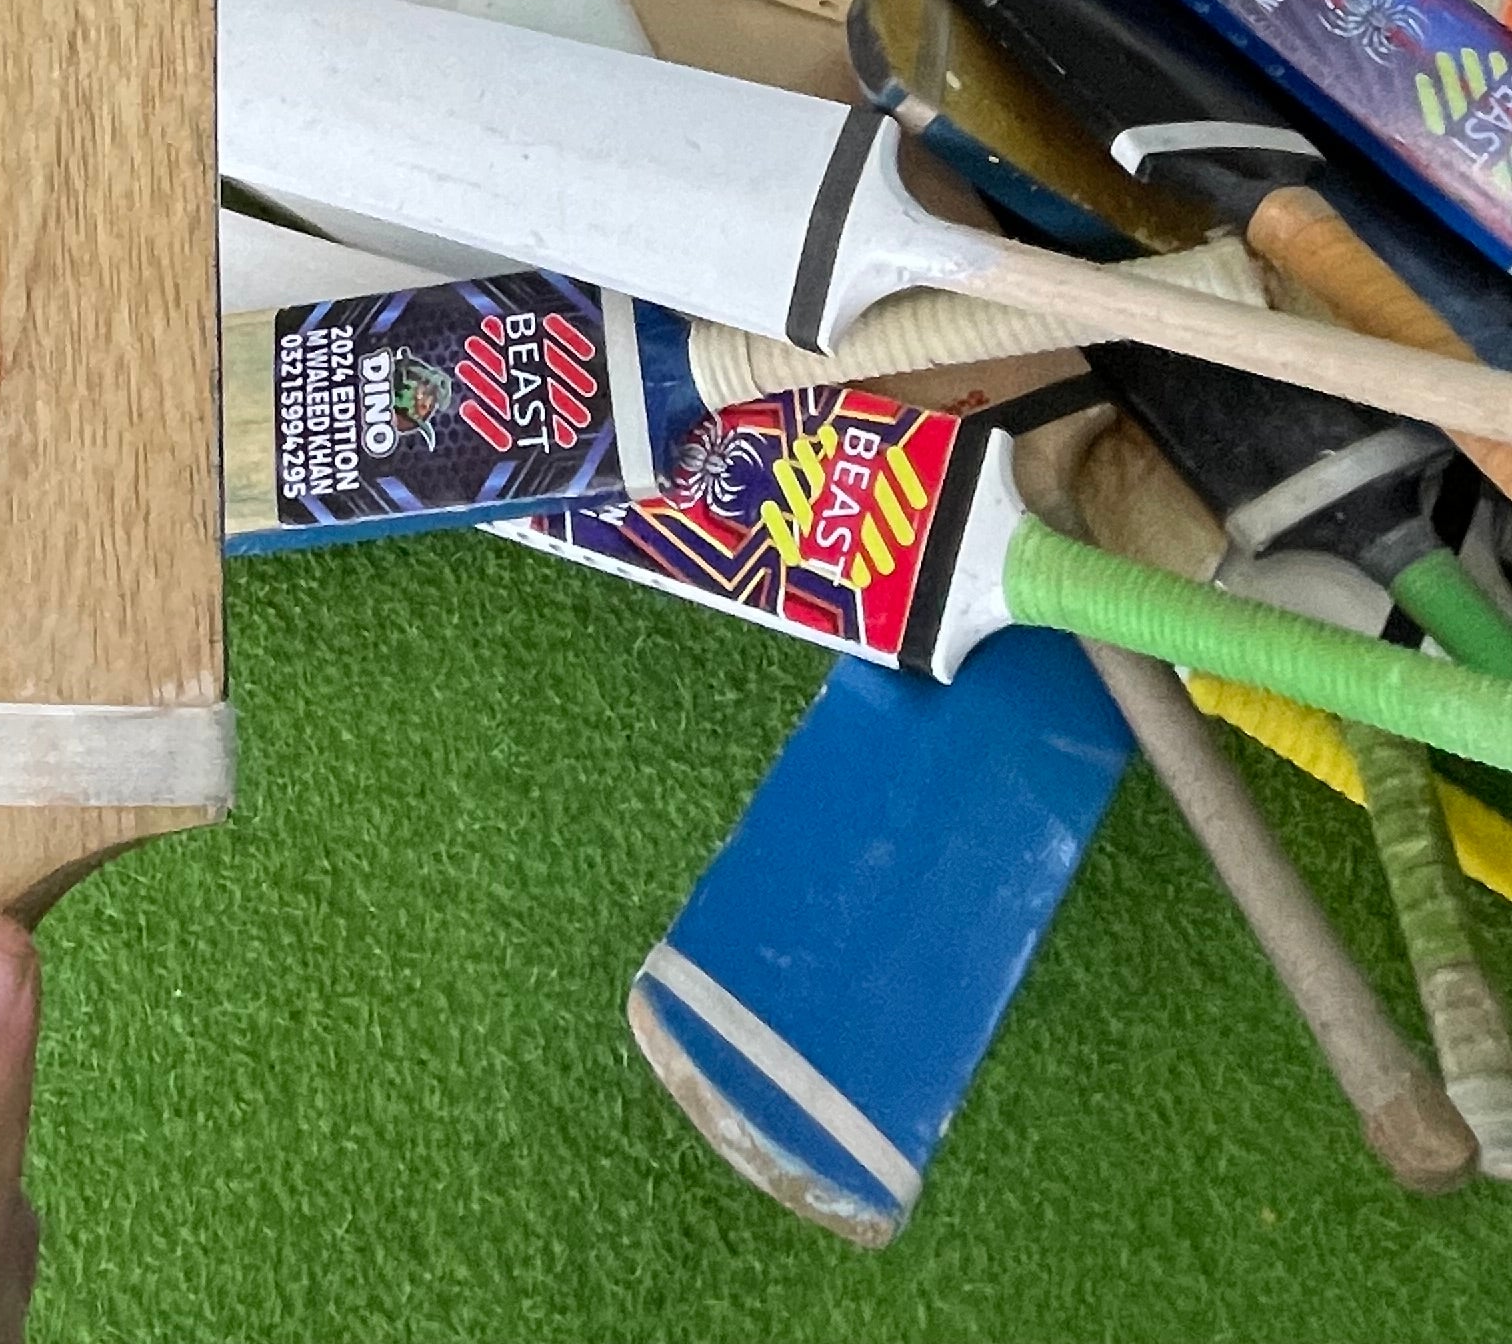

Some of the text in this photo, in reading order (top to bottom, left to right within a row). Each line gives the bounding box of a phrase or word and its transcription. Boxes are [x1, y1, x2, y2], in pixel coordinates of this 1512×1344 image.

[280, 334, 306, 499] 03215994295
[306, 348, 330, 433] WALEED
[331, 324, 360, 491] 2024 EDITION
[362, 357, 395, 452] DINO
[505, 312, 550, 454] BEAST
[308, 434, 334, 495] KHAN
[816, 426, 882, 587] BEAST
